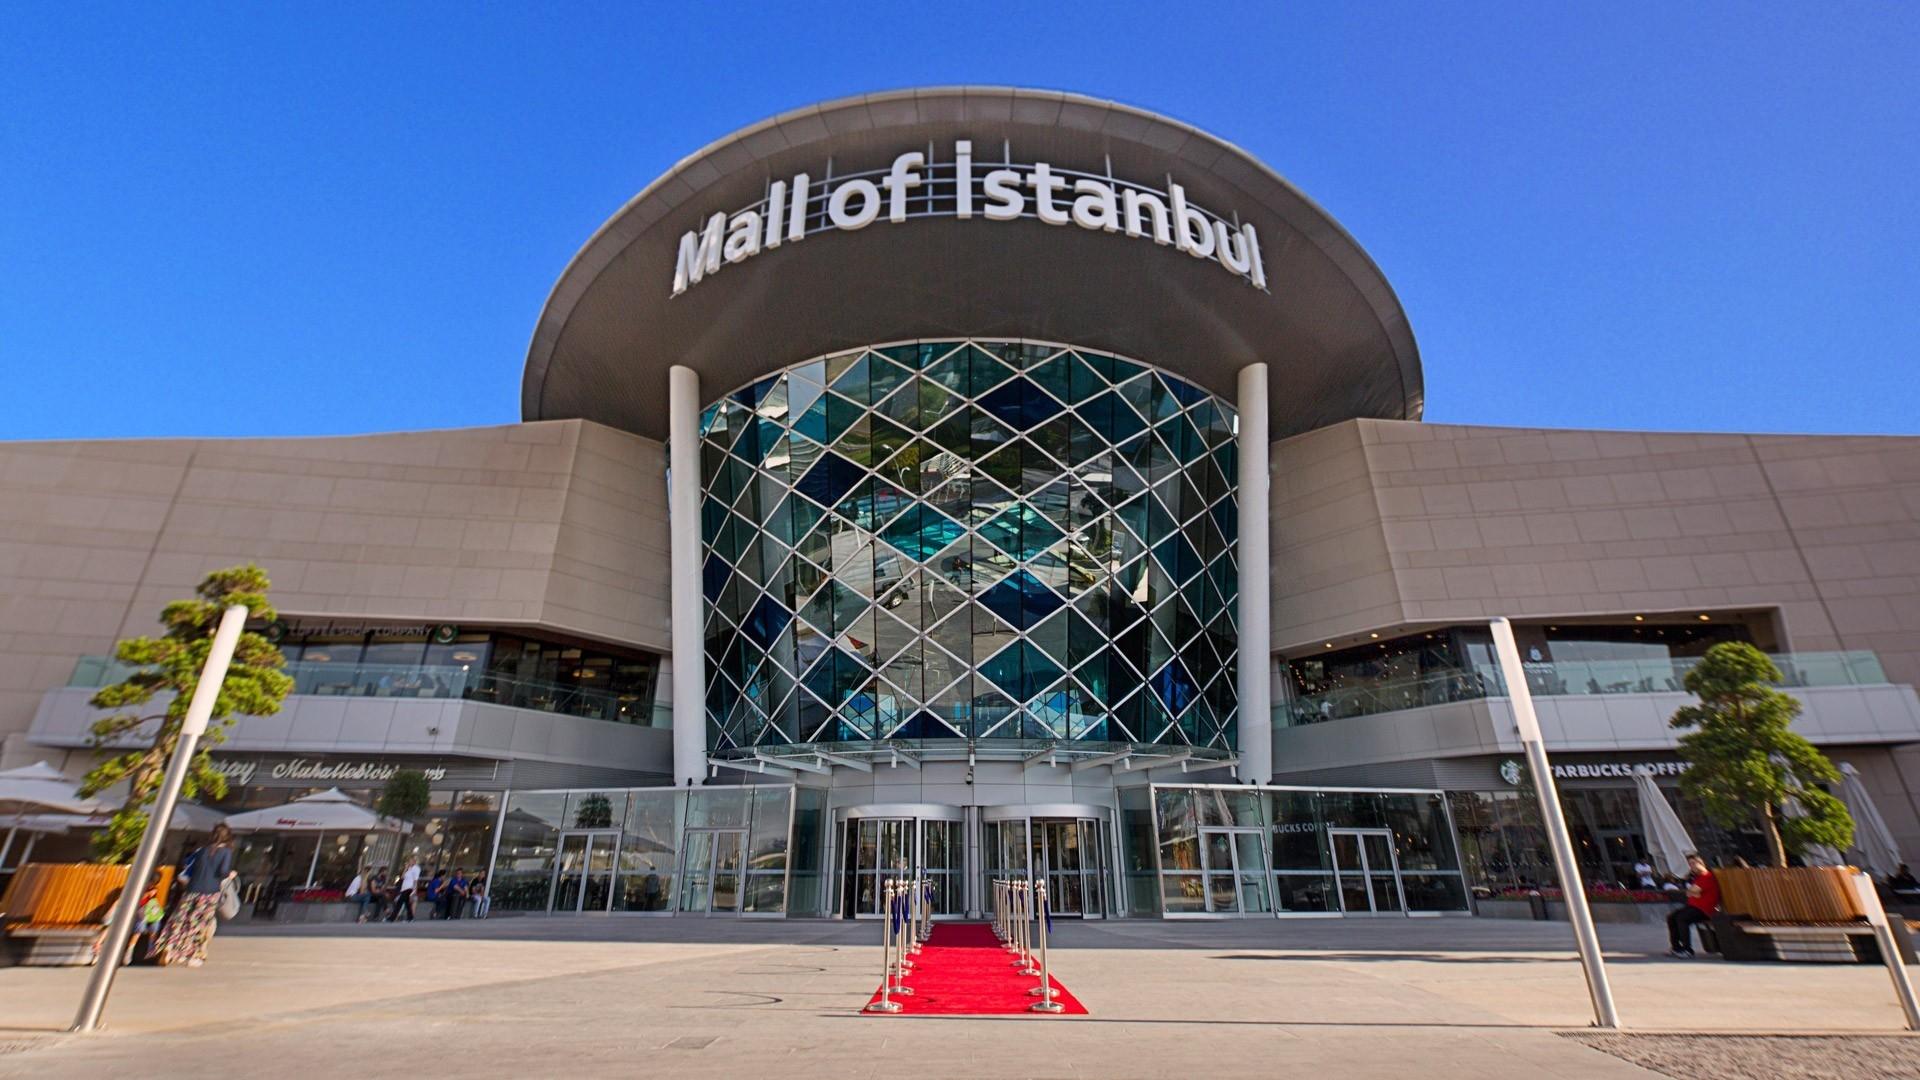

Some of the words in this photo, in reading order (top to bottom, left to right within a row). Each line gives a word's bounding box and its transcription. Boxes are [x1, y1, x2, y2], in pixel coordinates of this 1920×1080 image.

[673, 173, 810, 294] Mall
[828, 152, 924, 231] of
[1552, 763, 1633, 778] ARBUCKS
[1637, 761, 1695, 776] OFFE
[1272, 822, 1301, 834] BUCKS
